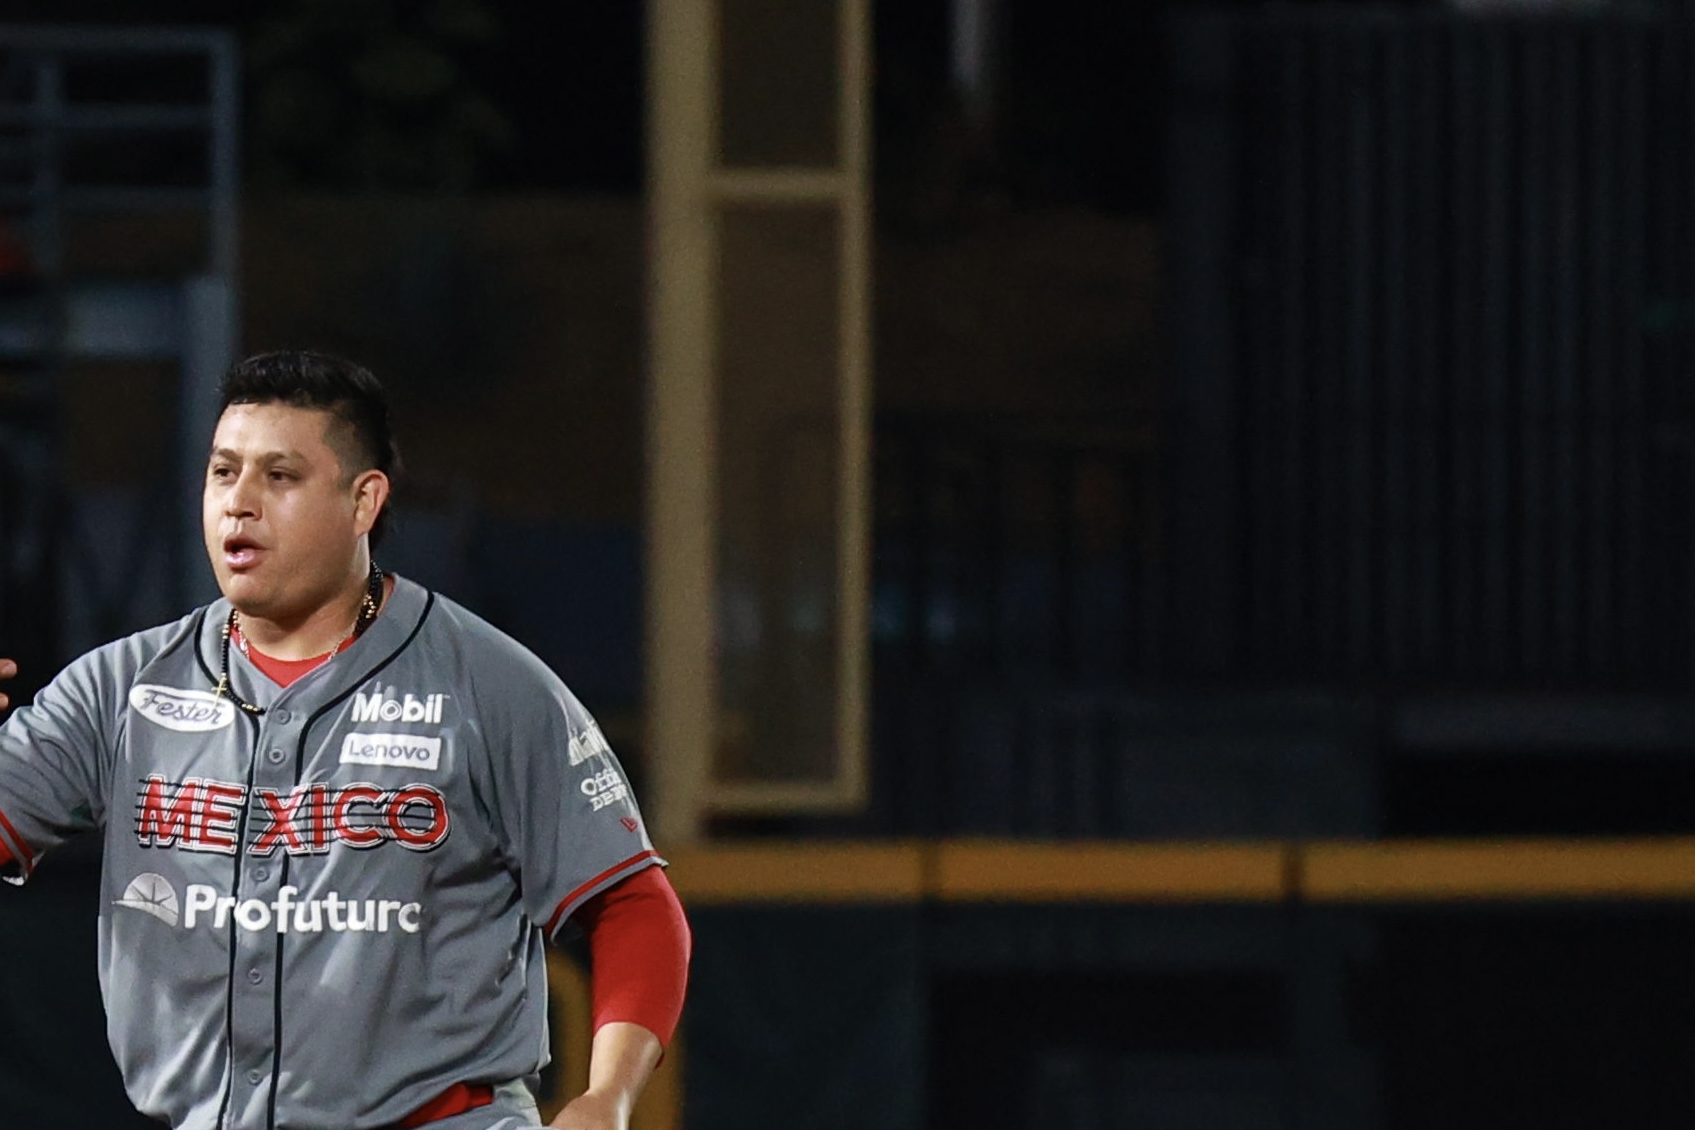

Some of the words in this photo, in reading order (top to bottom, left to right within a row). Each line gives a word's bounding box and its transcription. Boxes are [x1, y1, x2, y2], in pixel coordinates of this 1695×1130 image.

[140, 688, 225, 725] Fester
[350, 692, 443, 724] Mobil
[349, 740, 431, 761] Lenovo
[138, 773, 451, 856] MEXICO
